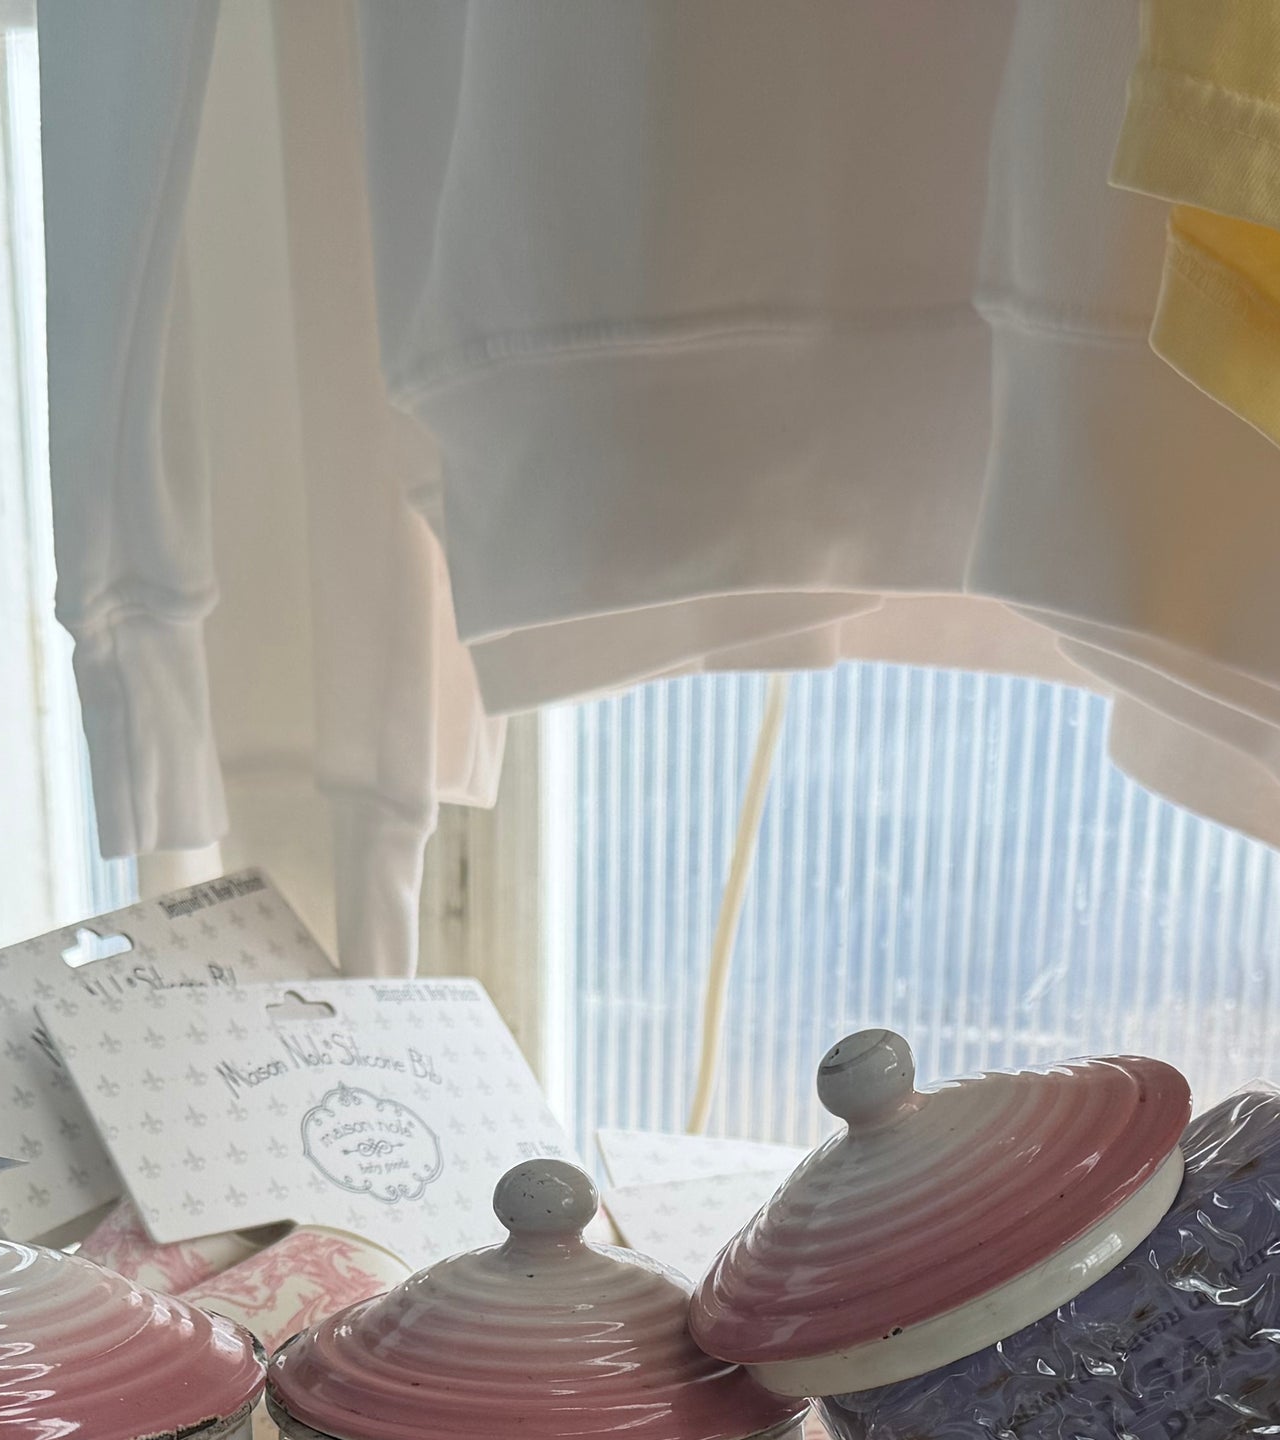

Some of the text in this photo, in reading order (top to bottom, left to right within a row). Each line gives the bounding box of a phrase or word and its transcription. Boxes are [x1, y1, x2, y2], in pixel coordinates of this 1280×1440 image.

[216, 1056, 288, 1099] Maison
[331, 1033, 407, 1073] Silicone
[408, 1047, 442, 1086] Bib
[320, 1120, 373, 1149] maison
